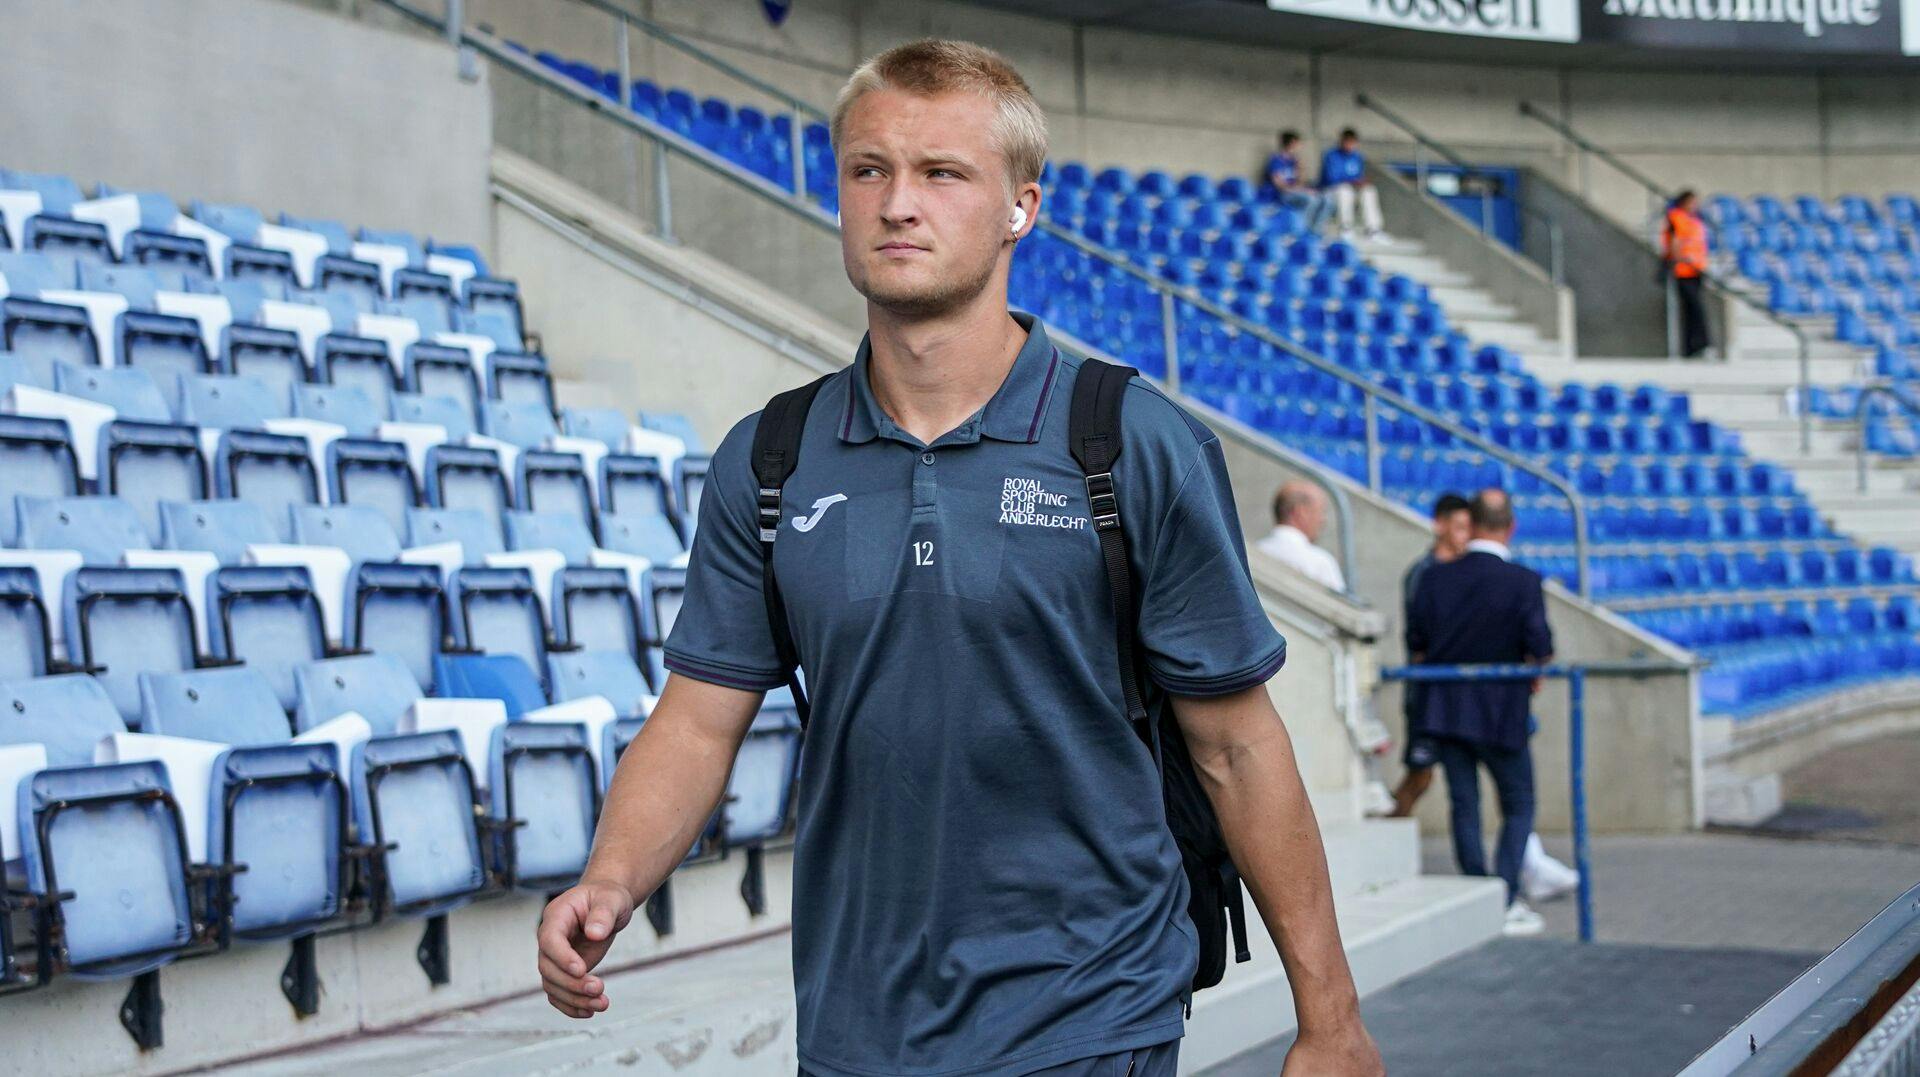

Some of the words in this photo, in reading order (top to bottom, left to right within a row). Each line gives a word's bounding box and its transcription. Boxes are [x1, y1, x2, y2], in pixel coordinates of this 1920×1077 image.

[1367, 0, 1540, 29] ossen
[1003, 477, 1045, 493] ROYAL
[1000, 500, 1035, 514] CLUB
[1001, 489, 1067, 507] SPORTING
[999, 511, 1087, 530] ANDERLECHT
[912, 541, 934, 566] 12
